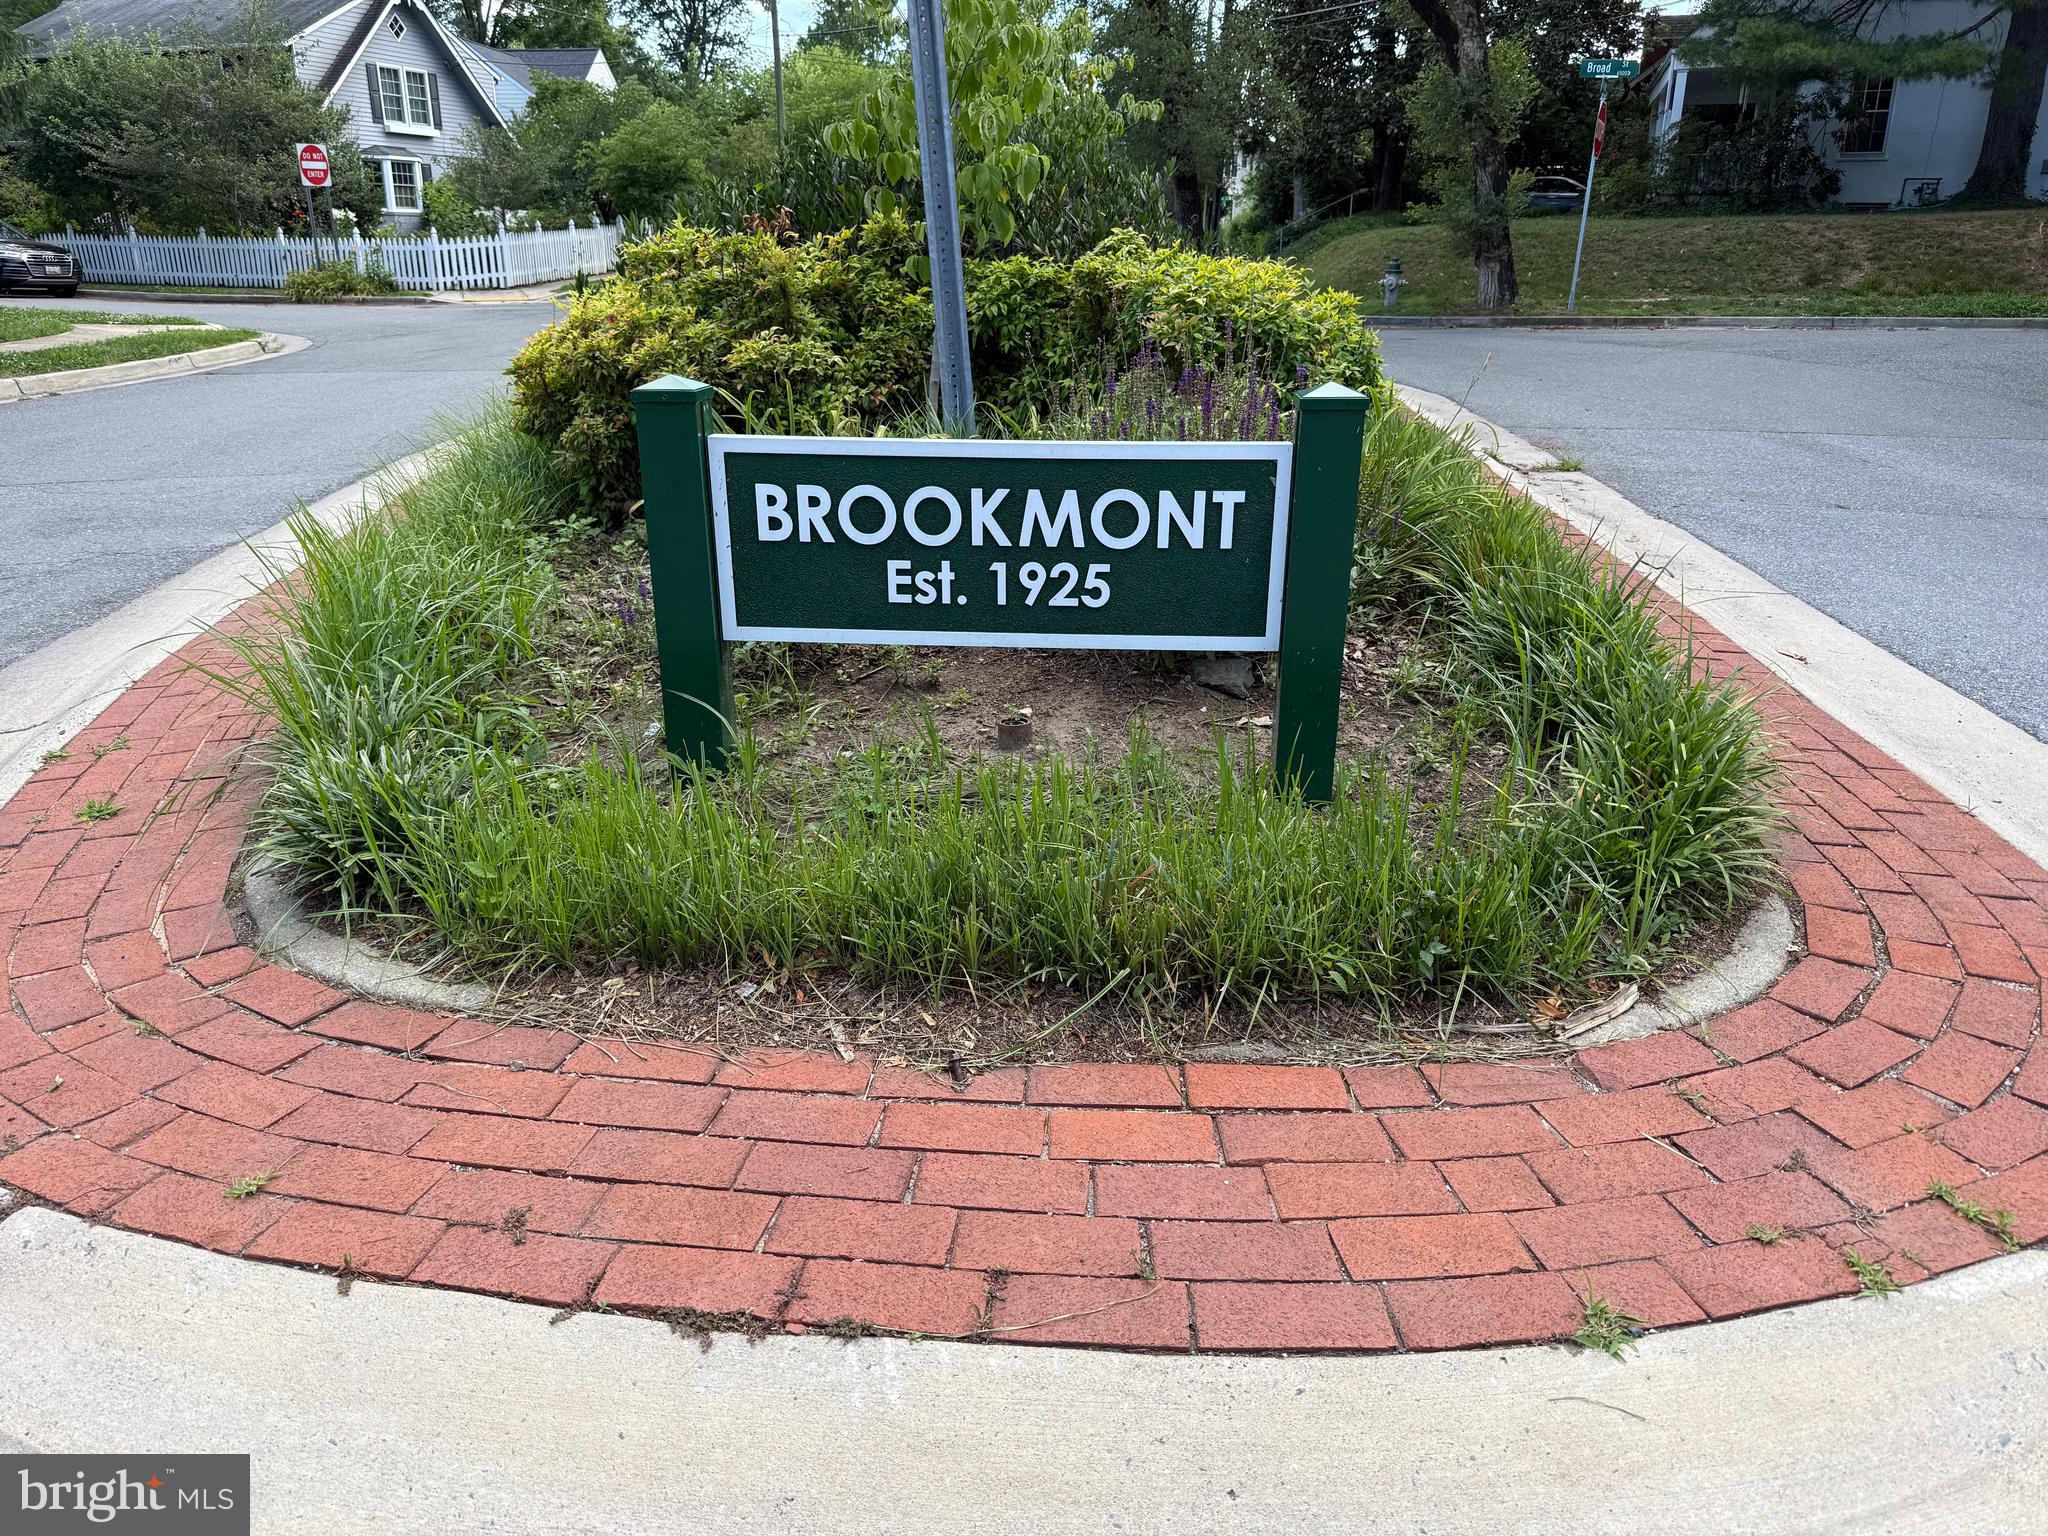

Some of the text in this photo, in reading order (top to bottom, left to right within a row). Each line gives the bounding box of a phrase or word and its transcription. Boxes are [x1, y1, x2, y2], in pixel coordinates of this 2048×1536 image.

[1586, 60, 1629, 73] Broad St
[312, 152, 323, 160] NOT
[307, 170, 324, 178] ENTER
[754, 483, 1246, 550] BROOKMONT
[886, 559, 1111, 608] Est. 1925
